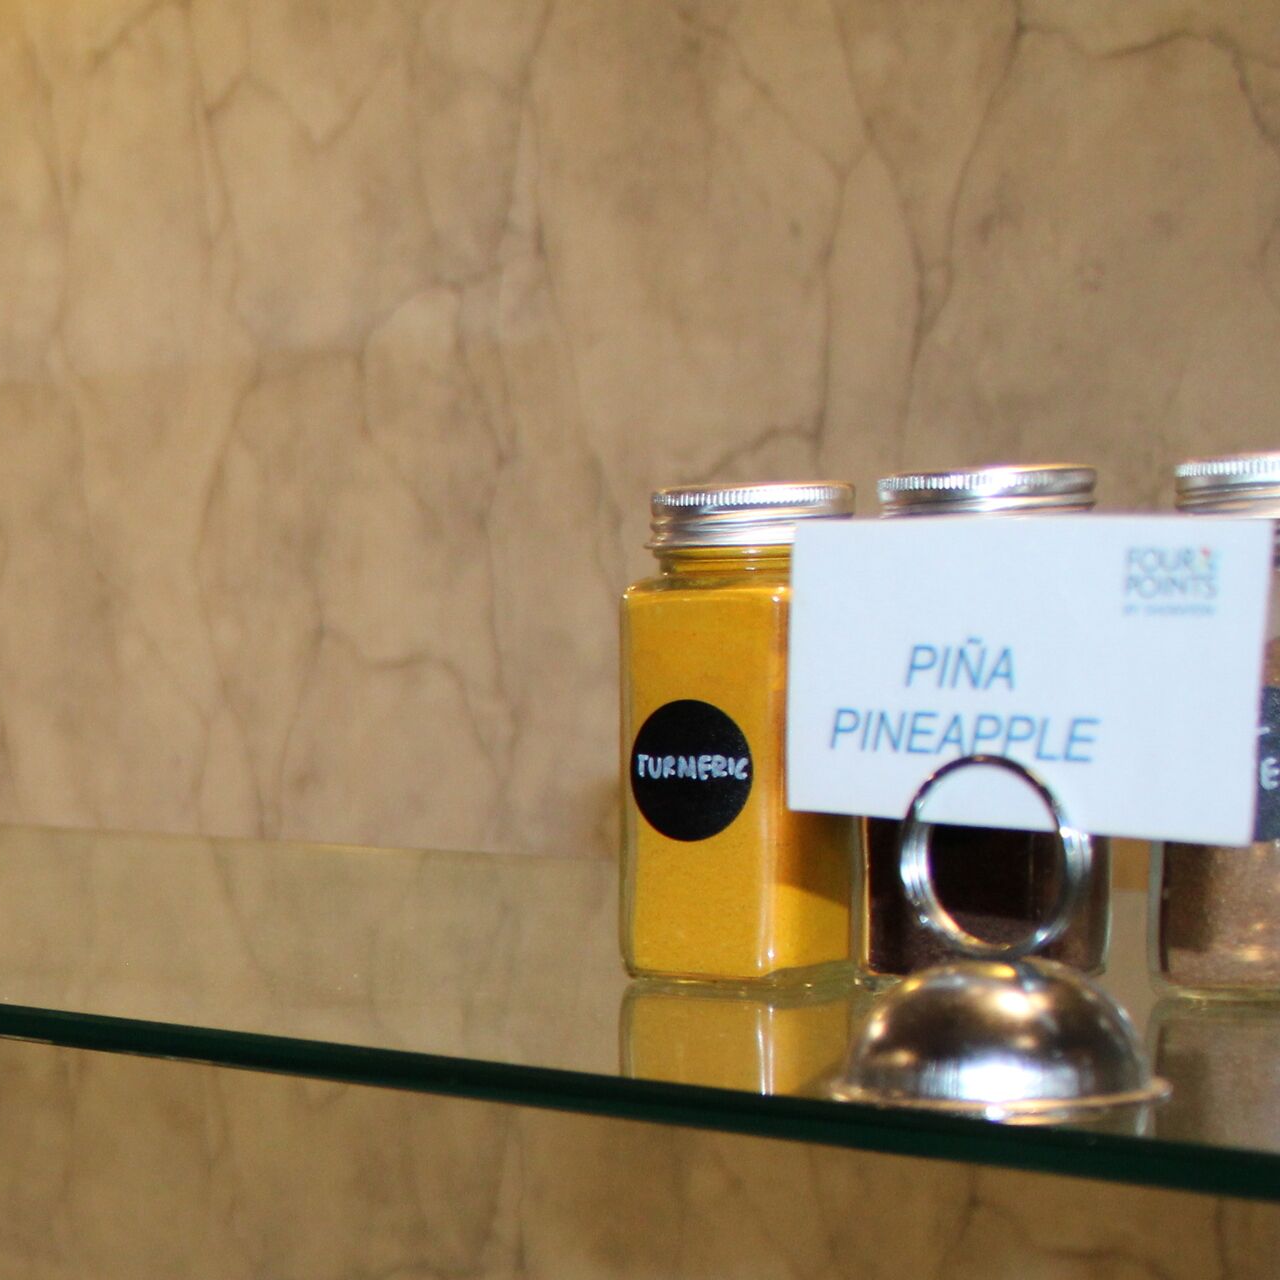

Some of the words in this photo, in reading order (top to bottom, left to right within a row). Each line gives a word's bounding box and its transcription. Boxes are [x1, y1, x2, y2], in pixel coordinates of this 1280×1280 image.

[1126, 546, 1195, 572] FOUR
[1125, 575, 1217, 599] POINTS
[905, 636, 1015, 690] PIÑA
[831, 707, 1101, 762] PINEAPPLE
[637, 753, 749, 780] TURMERIC
